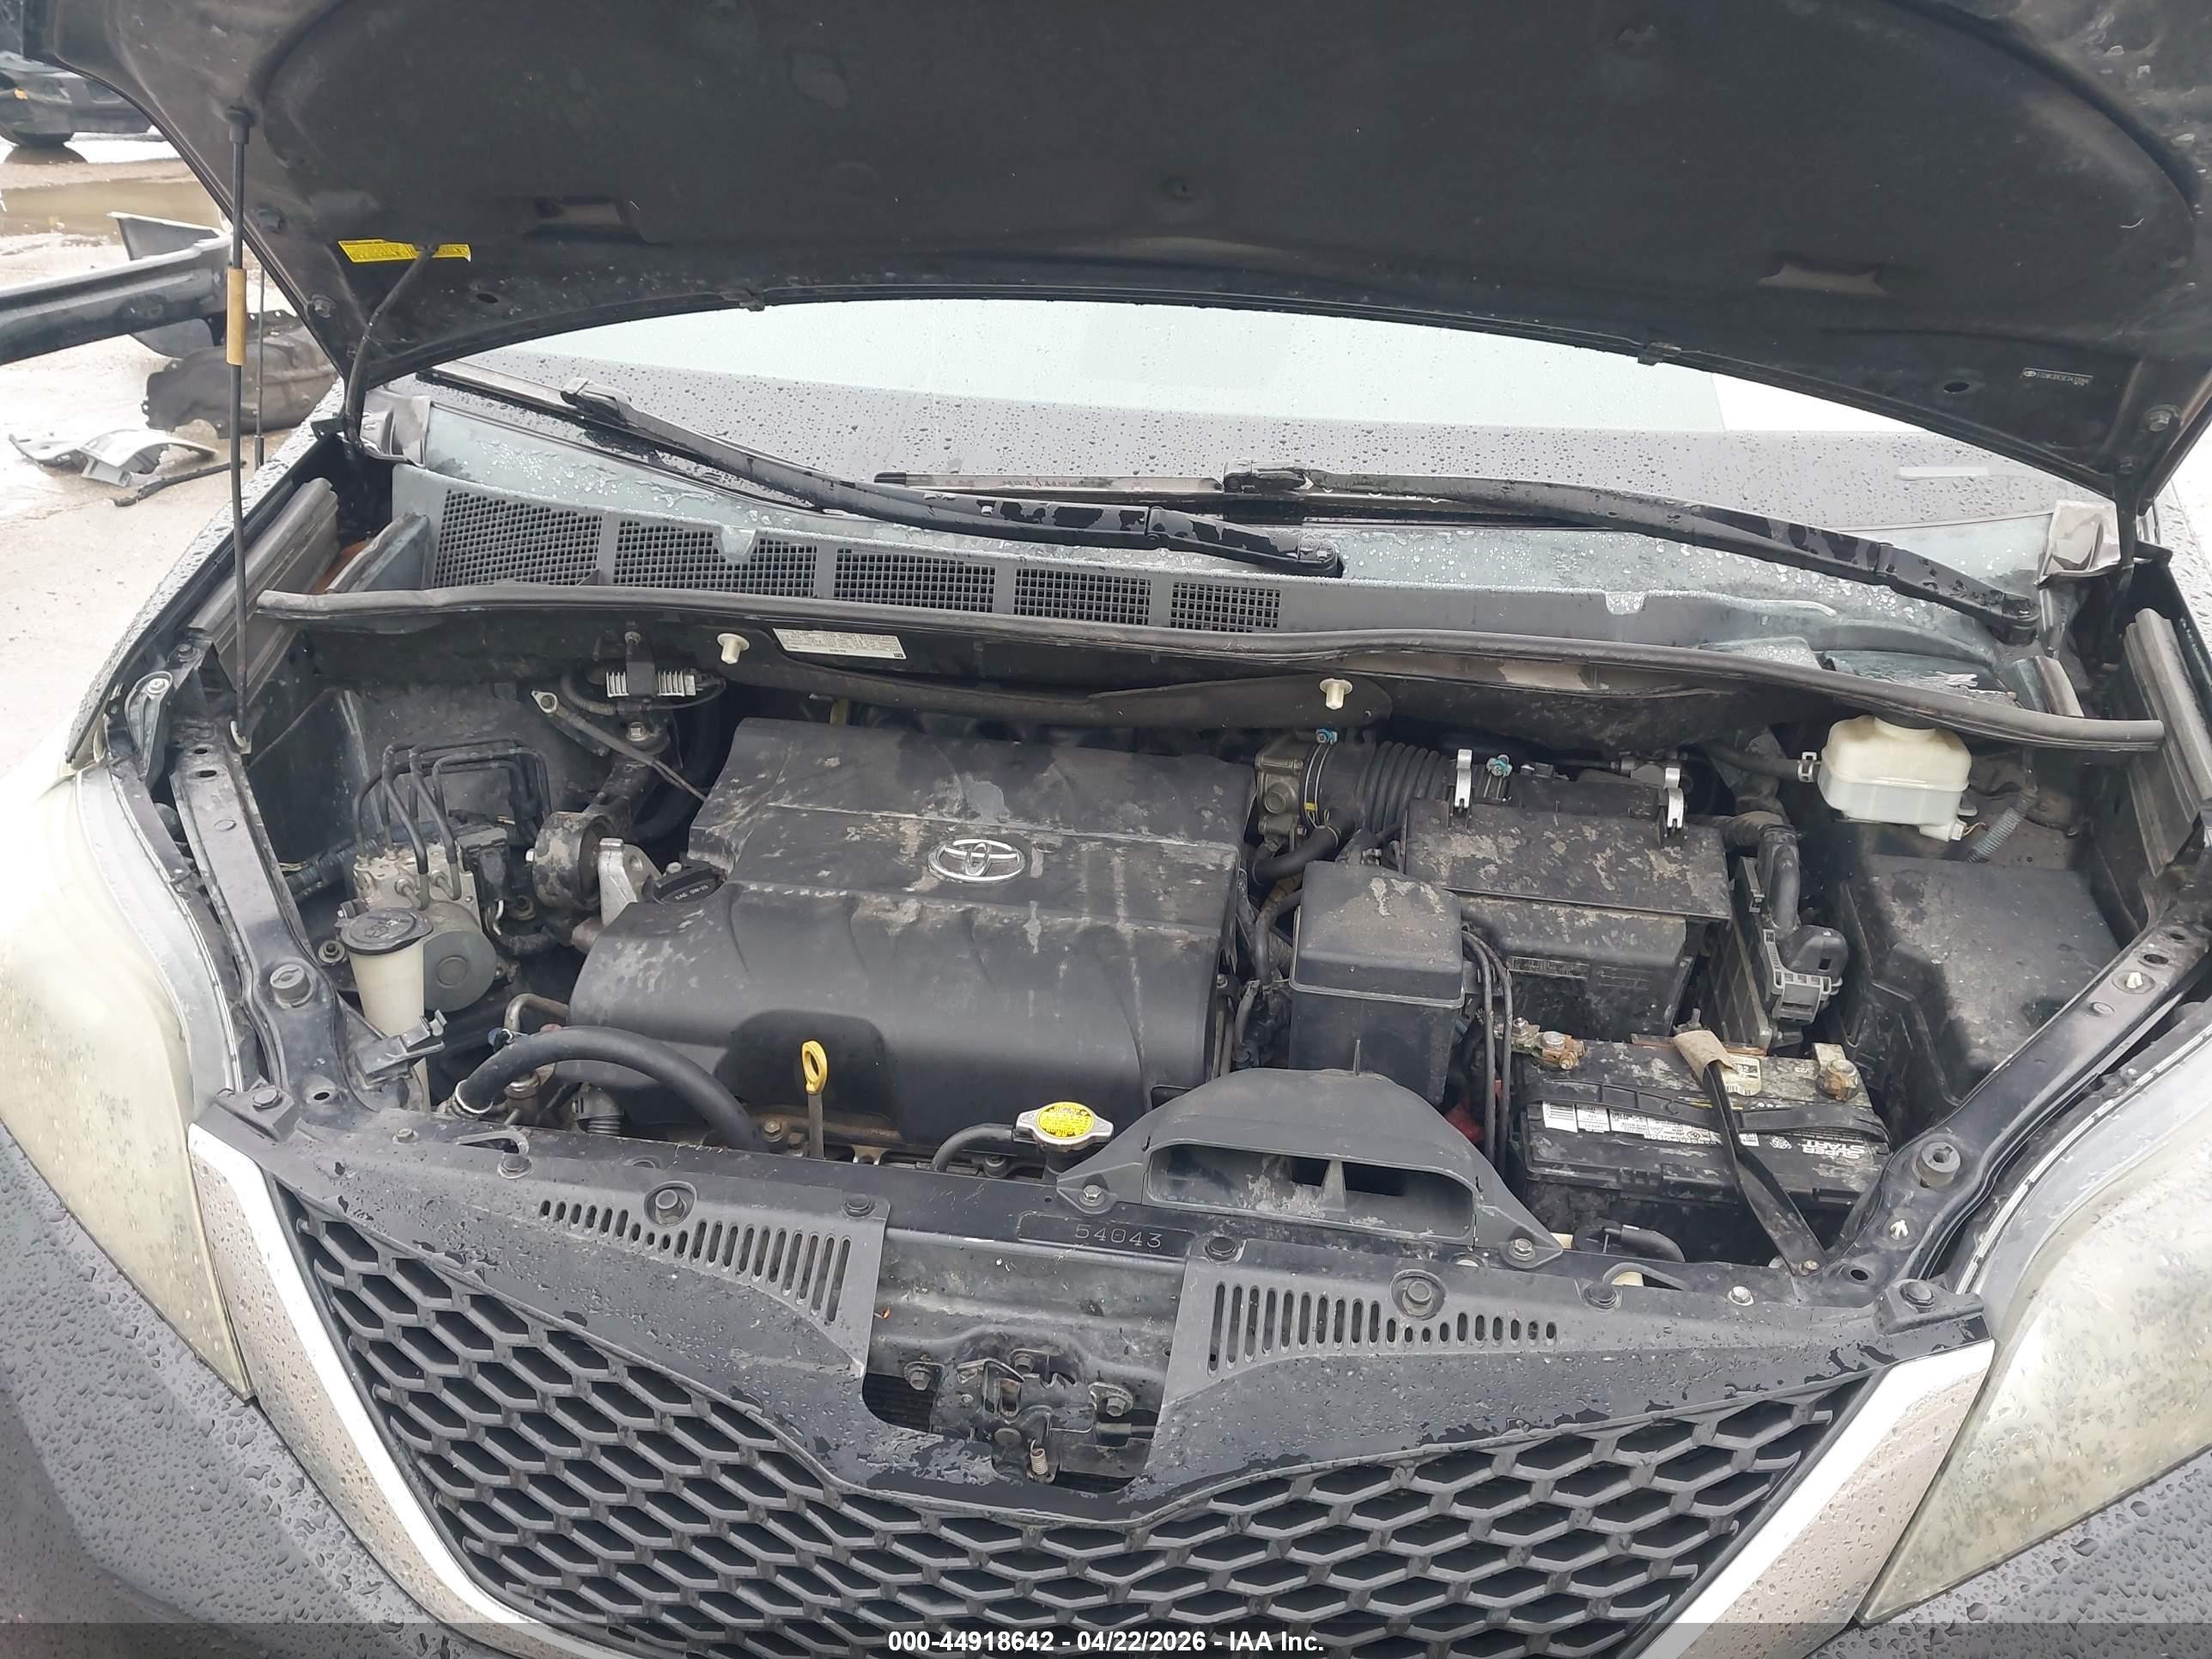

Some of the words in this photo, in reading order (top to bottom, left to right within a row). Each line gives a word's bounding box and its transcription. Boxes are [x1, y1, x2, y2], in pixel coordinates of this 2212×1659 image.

[1800, 1139, 1865, 1154] START
[1802, 1146, 1860, 1159] SUPER
[1075, 1224, 1163, 1248] 54043
